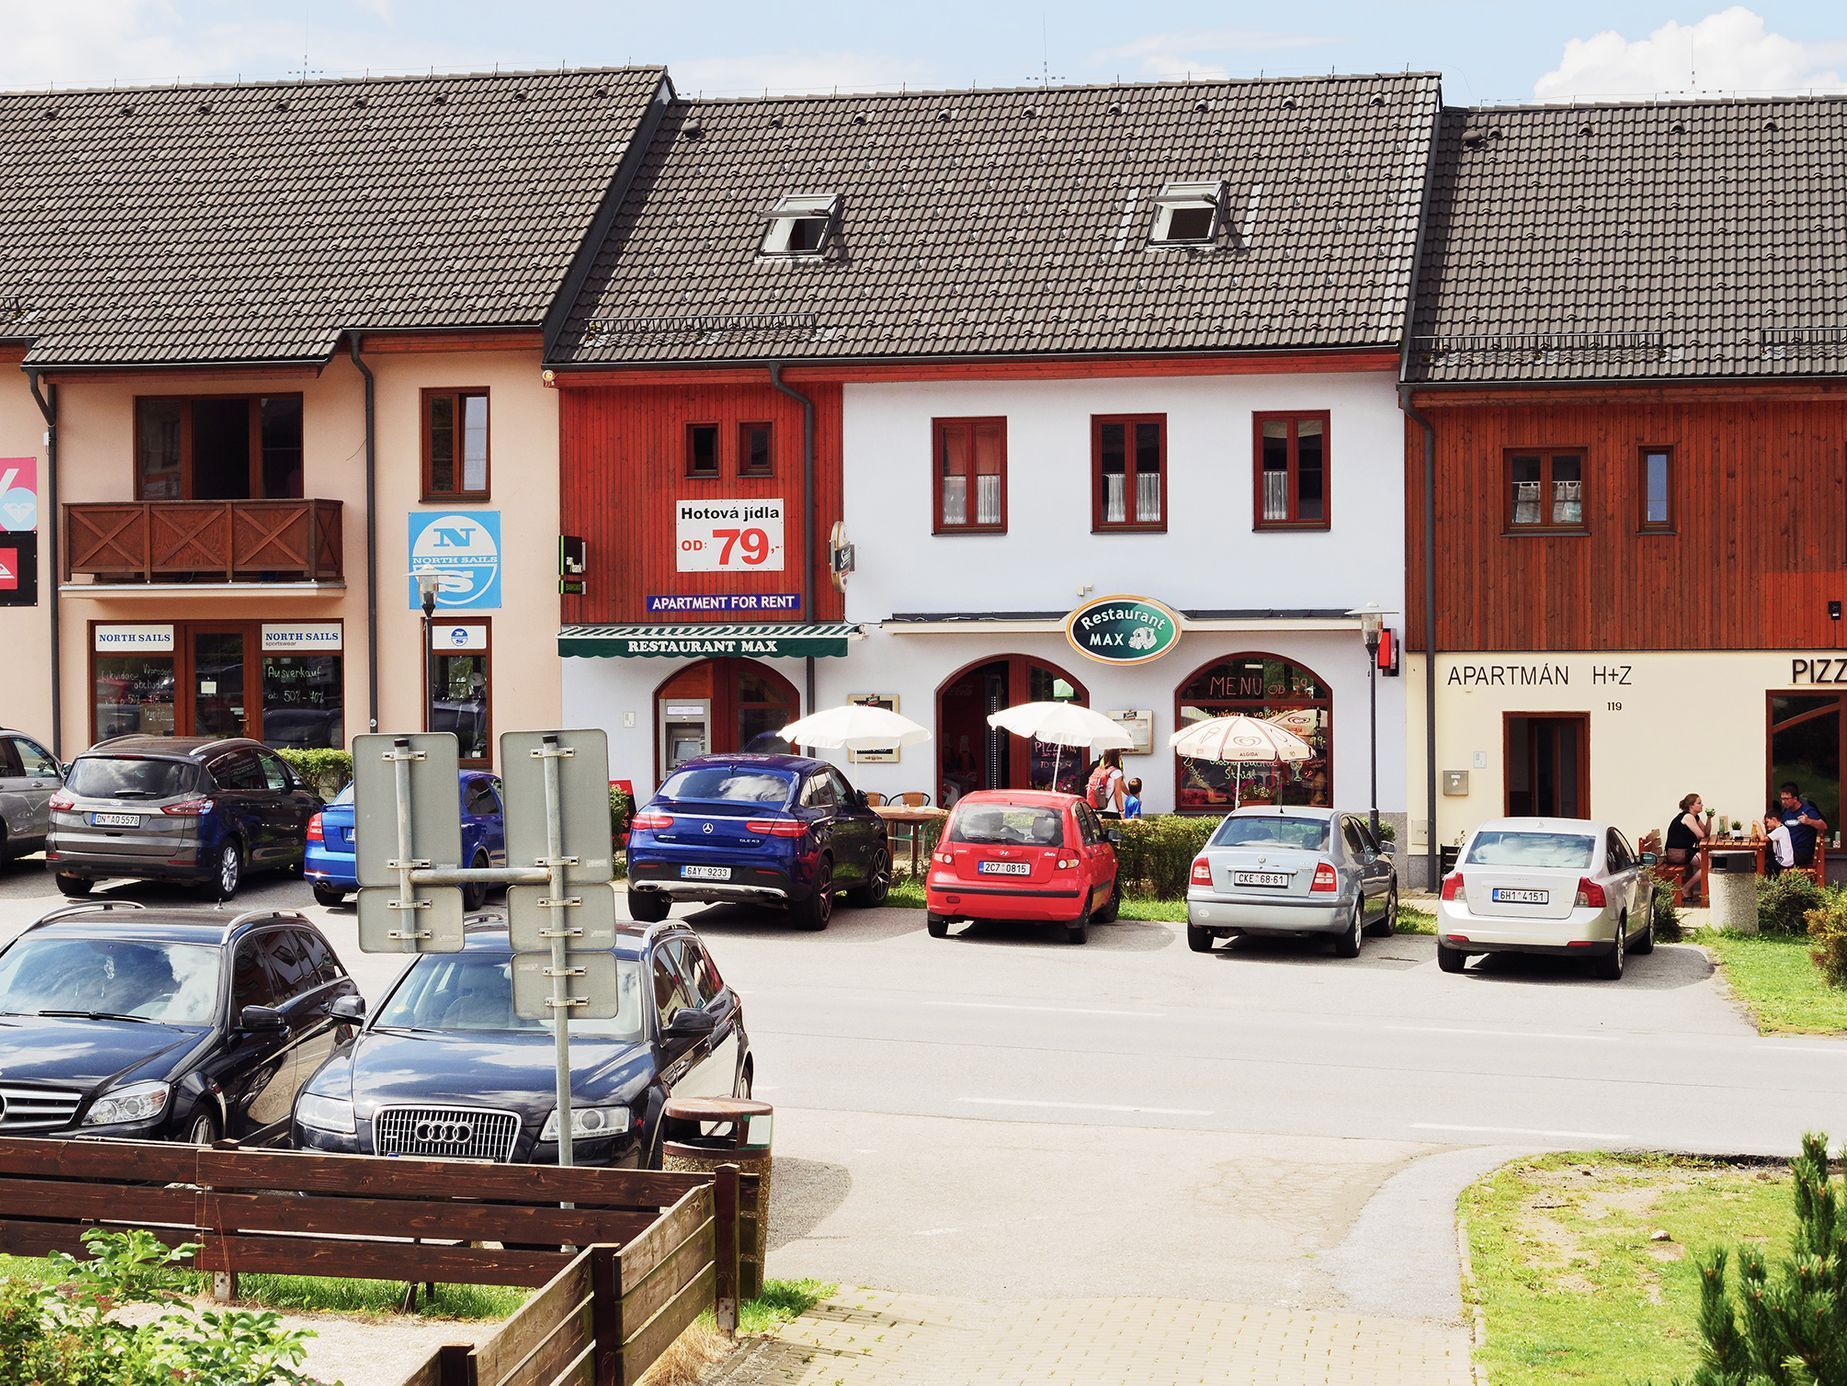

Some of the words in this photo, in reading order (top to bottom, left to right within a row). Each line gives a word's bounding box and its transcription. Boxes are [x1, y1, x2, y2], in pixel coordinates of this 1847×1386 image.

[680, 507, 739, 520] Hotová
[743, 506, 780, 522] jídla
[433, 528, 476, 547] N
[712, 528, 780, 566] 79,-
[413, 556, 459, 564] NORTH
[461, 556, 498, 564] SAILS
[652, 597, 728, 610] APARTMENT
[731, 596, 758, 609] FOR
[761, 596, 795, 608] RENT
[1080, 608, 1167, 631] Restaurant
[99, 634, 136, 642] NORTH
[138, 634, 171, 642] SAILS
[265, 632, 304, 641] NORTH
[305, 632, 339, 641] SAILS
[1089, 633, 1124, 646] MAX
[628, 640, 737, 653] RESTAURANT
[741, 640, 778, 653] MAX
[267, 666, 322, 680] Ausverkauf
[1447, 663, 1569, 686] APARTMÁN
[1592, 665, 1632, 686] H+Z
[1792, 659, 1847, 683] PIZZ
[1209, 676, 1263, 696] MENU
[1607, 702, 1622, 711] 119
[687, 866, 703, 875] 6AY
[707, 867, 728, 877] 9233
[985, 863, 1001, 871] 2C7
[1006, 864, 1027, 873] 0815
[1238, 873, 1255, 883] CKE
[1500, 890, 1516, 900] 6H1
[1522, 891, 1544, 901] 4151
